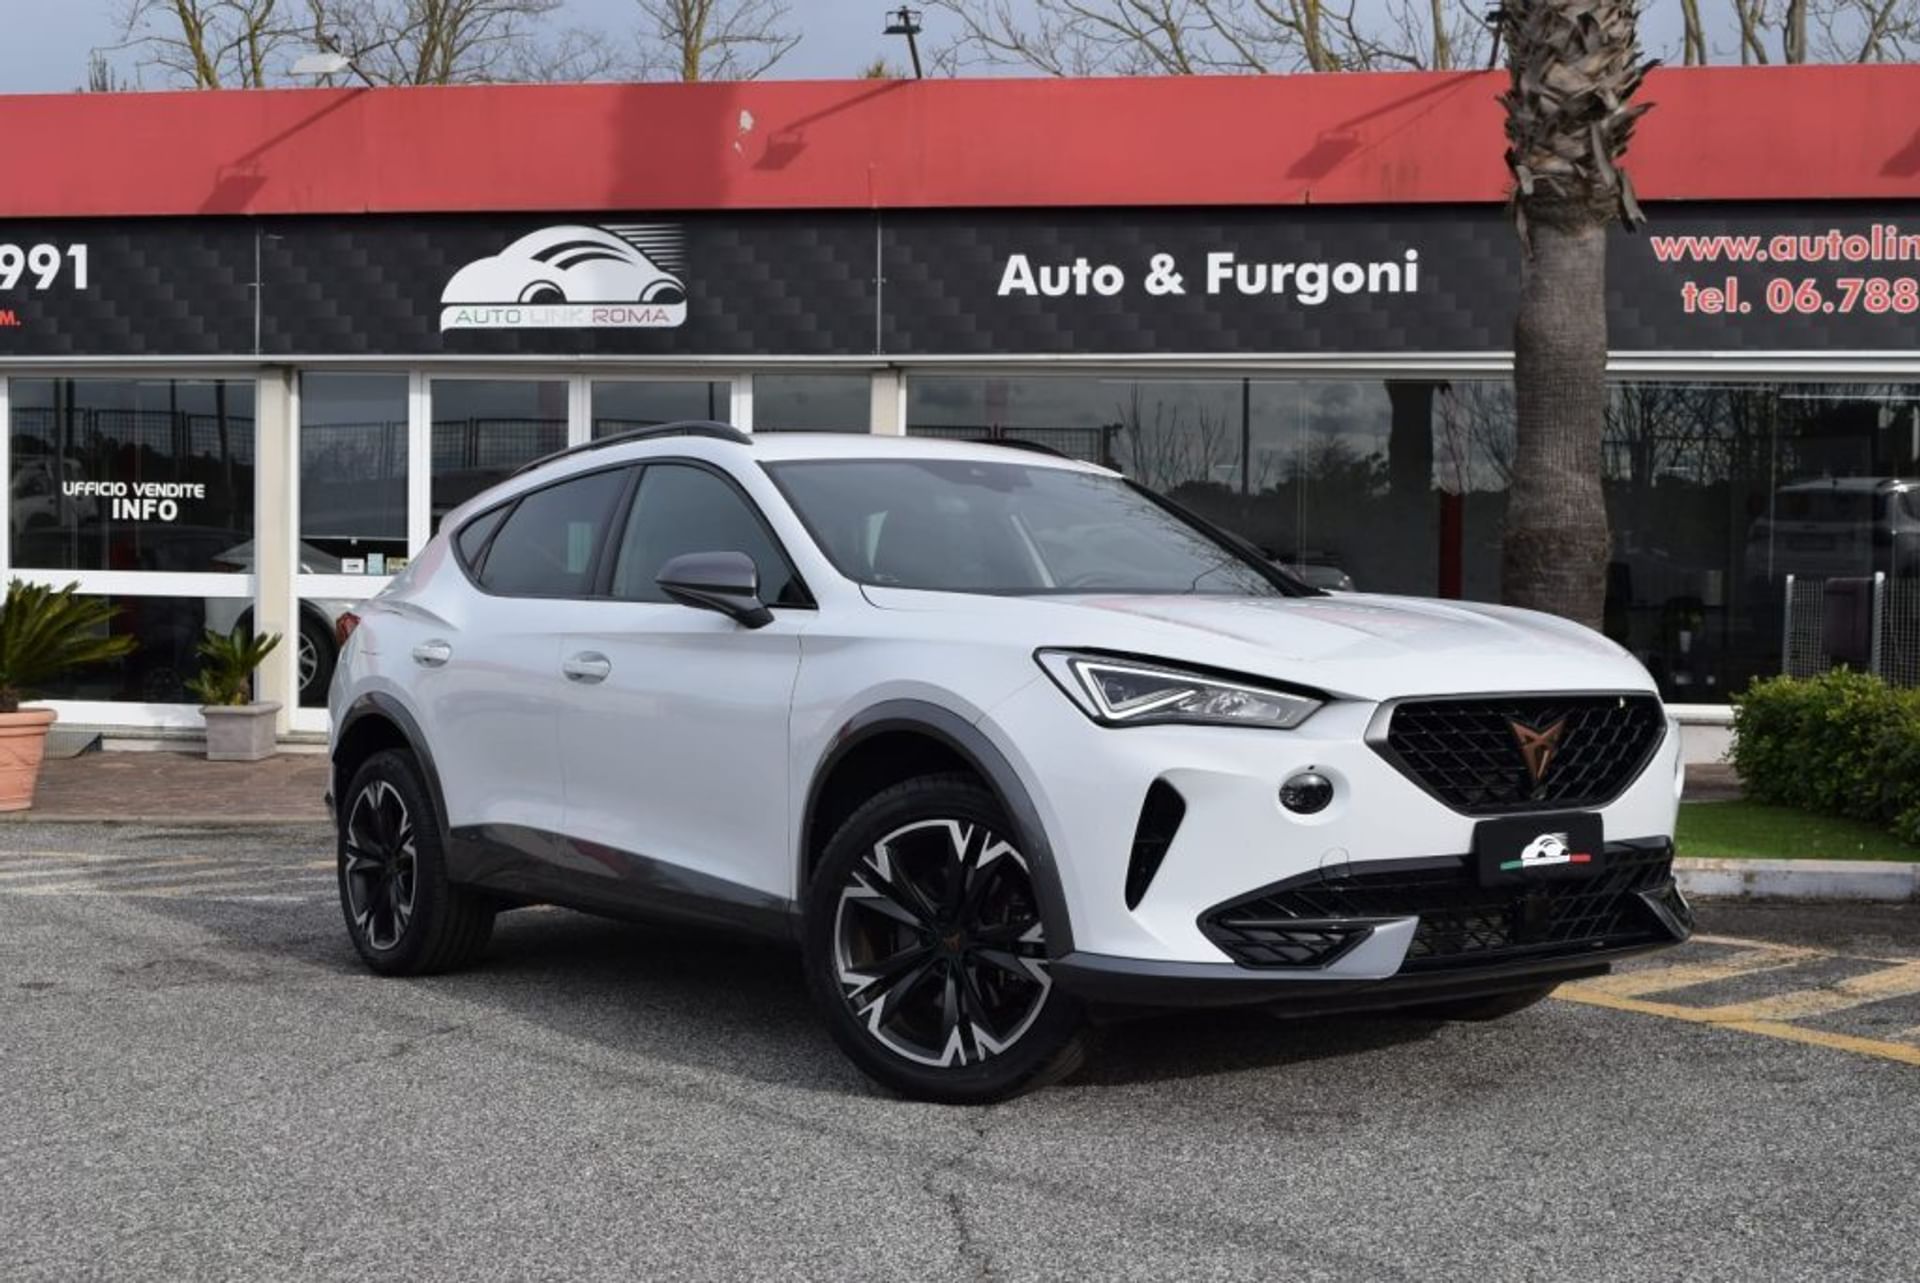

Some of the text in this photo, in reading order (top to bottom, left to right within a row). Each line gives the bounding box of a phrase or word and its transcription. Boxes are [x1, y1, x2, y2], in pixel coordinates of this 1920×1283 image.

[0, 243, 87, 290] 991
[997, 248, 1418, 305] Auto & Furgoni
[1681, 276, 1920, 314] tel. 06.788
[455, 308, 671, 324] AUTO LINK ROMA
[62, 481, 205, 498] UFFICIO VENDITE
[112, 498, 178, 521] INFO
